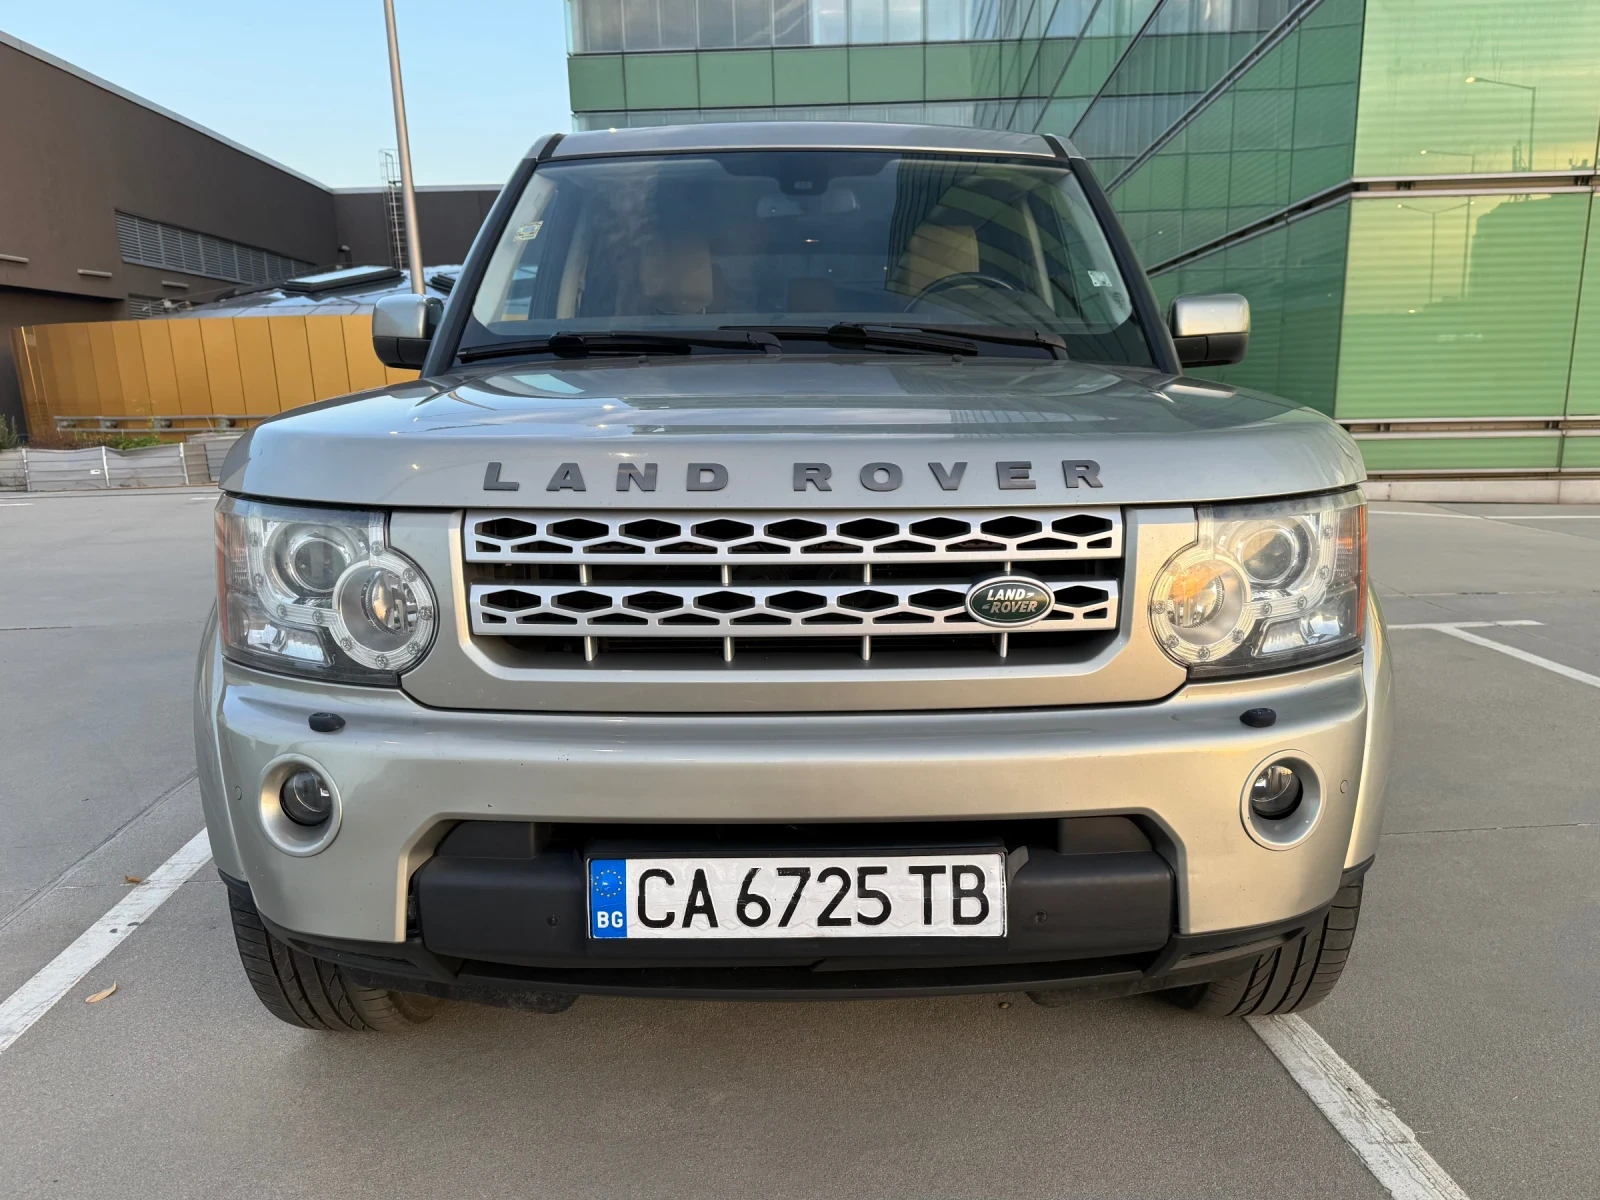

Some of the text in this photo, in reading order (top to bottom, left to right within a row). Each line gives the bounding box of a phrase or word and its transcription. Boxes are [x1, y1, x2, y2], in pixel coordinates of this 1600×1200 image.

[483, 459, 1104, 492] LAND ROVER
[987, 589, 1026, 601] LAND
[990, 601, 1038, 613] ROVER
[637, 865, 987, 928] CA 6725 TB
[597, 910, 623, 928] BG
